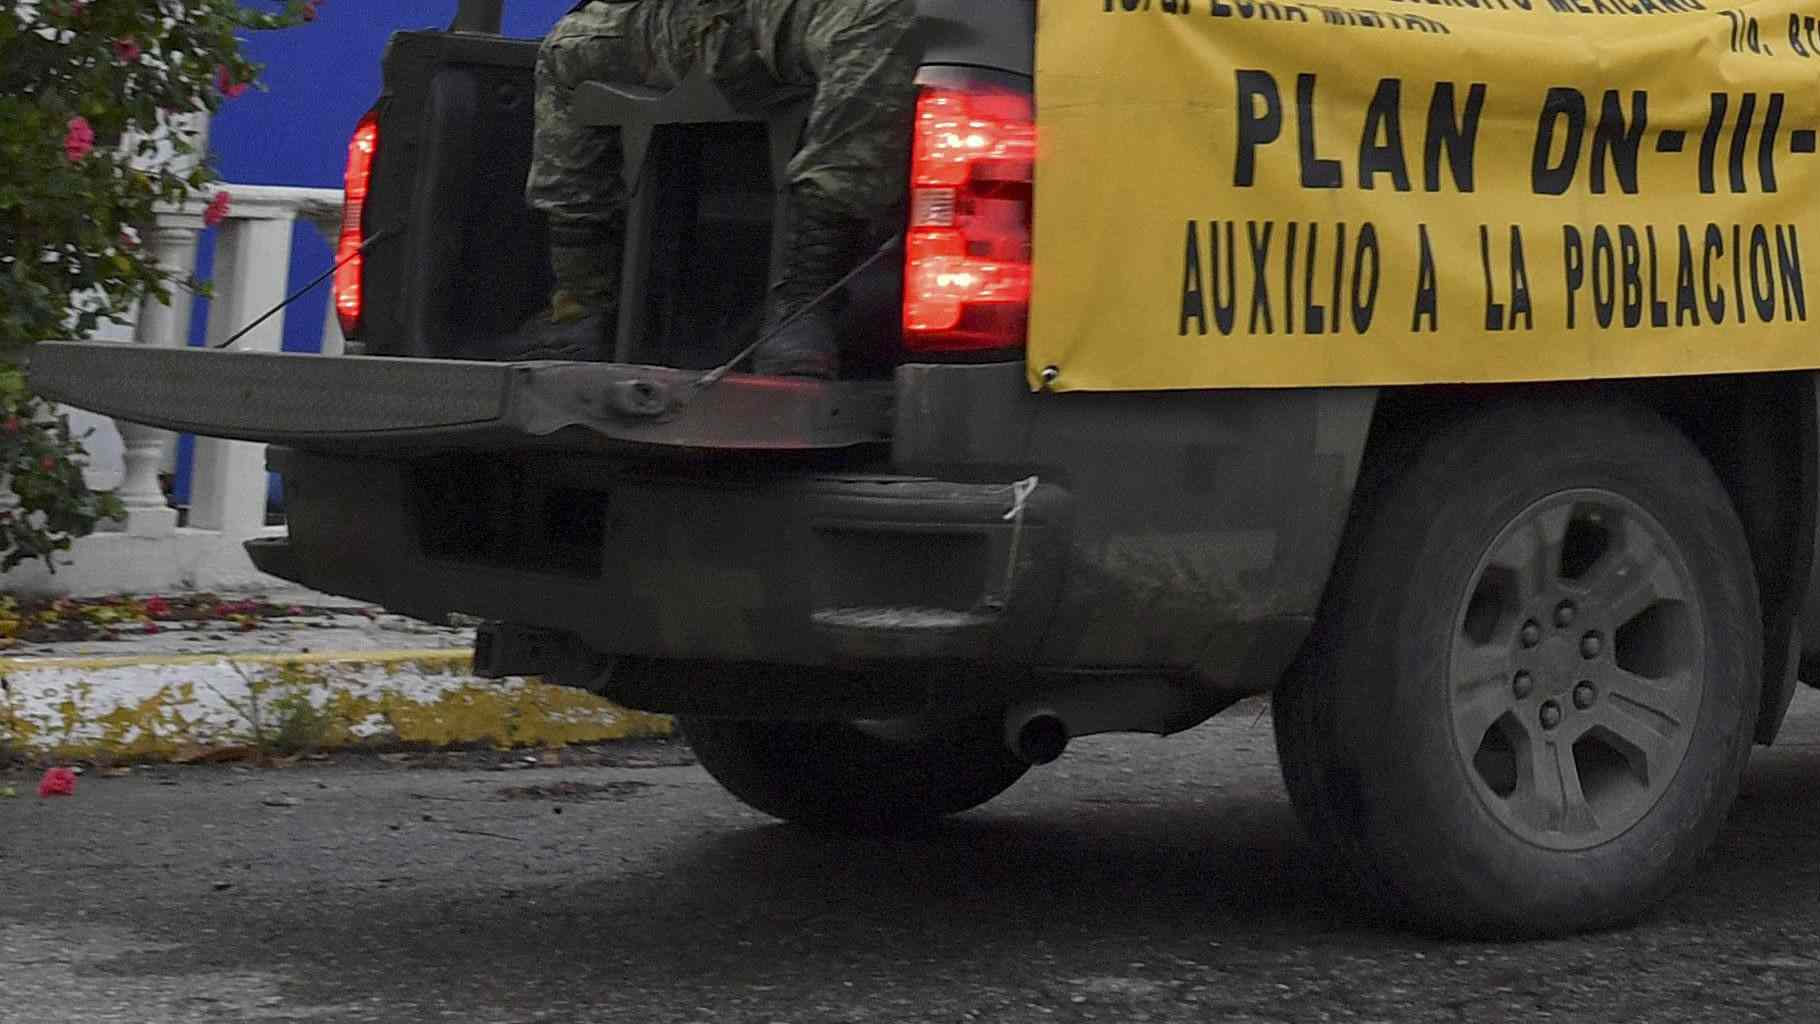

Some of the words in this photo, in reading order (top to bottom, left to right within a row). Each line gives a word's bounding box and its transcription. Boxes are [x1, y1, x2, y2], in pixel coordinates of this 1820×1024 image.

[1232, 68, 1488, 193] PLAN
[1178, 219, 1380, 336] AUXILIO
[1411, 223, 1439, 333] A
[1478, 224, 1534, 332] LA
[1562, 222, 1807, 330] POBLACION
